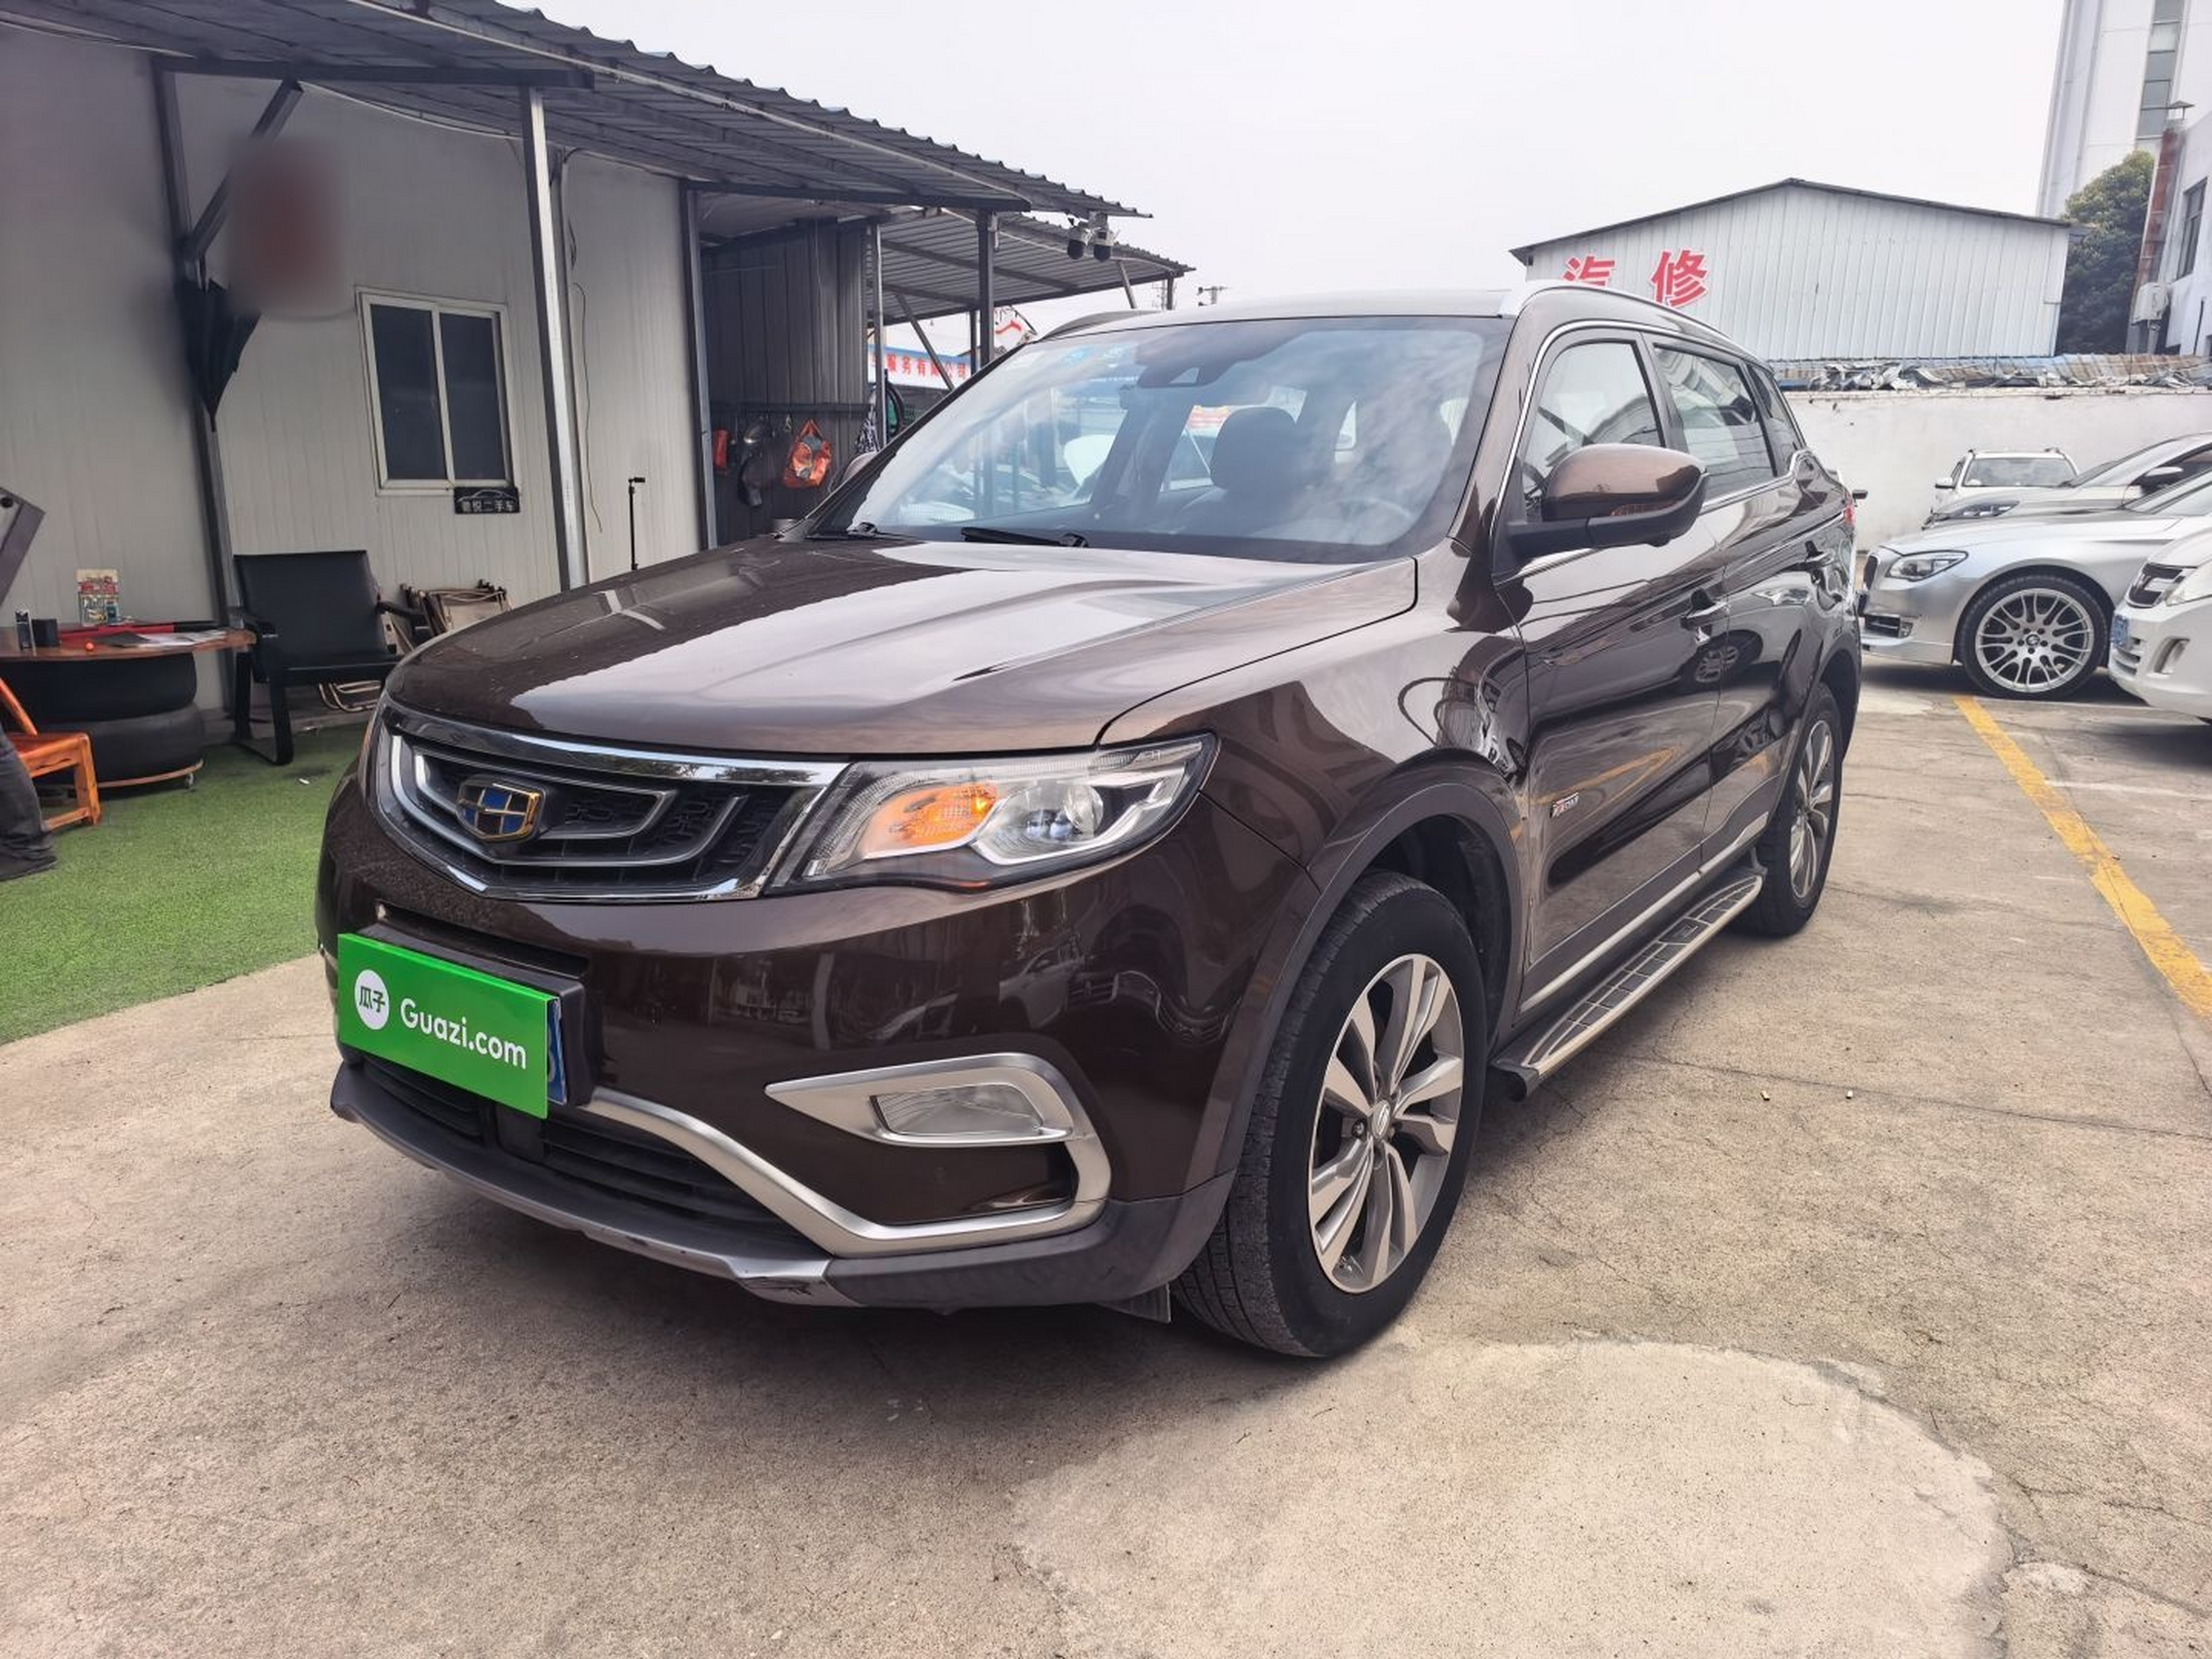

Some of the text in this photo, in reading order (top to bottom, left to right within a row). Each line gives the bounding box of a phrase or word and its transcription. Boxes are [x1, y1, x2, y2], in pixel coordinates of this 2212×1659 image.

[872, 352, 966, 379] 服务有限公司
[359, 985, 385, 1013] 瓜子
[400, 998, 527, 1070] Guazi.com
